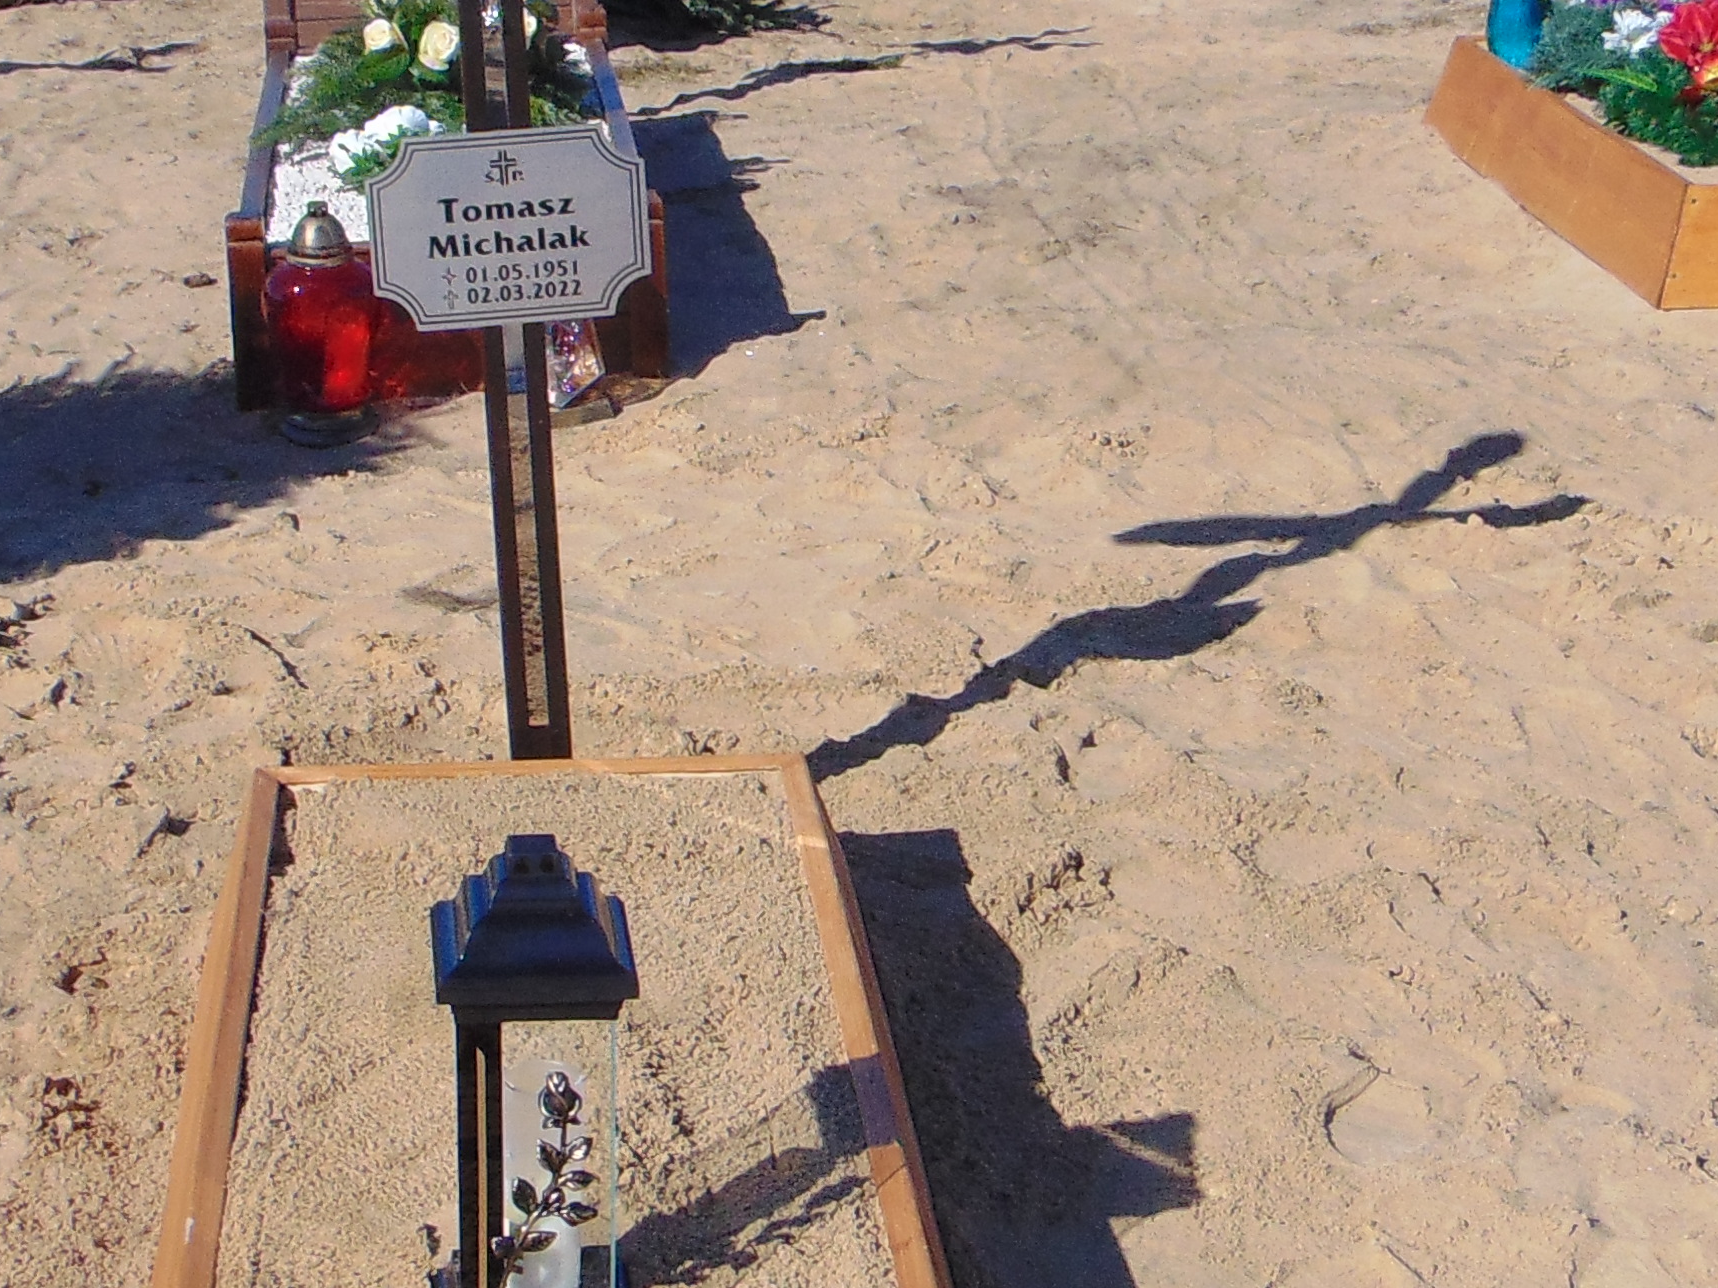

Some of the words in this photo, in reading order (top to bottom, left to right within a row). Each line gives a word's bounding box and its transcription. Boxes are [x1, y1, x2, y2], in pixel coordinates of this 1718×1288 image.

[437, 197, 575, 224] Tomasz
[428, 224, 591, 260] Michalak
[465, 259, 579, 284] 01.05.1951
[467, 279, 582, 304] 02.03.2022
